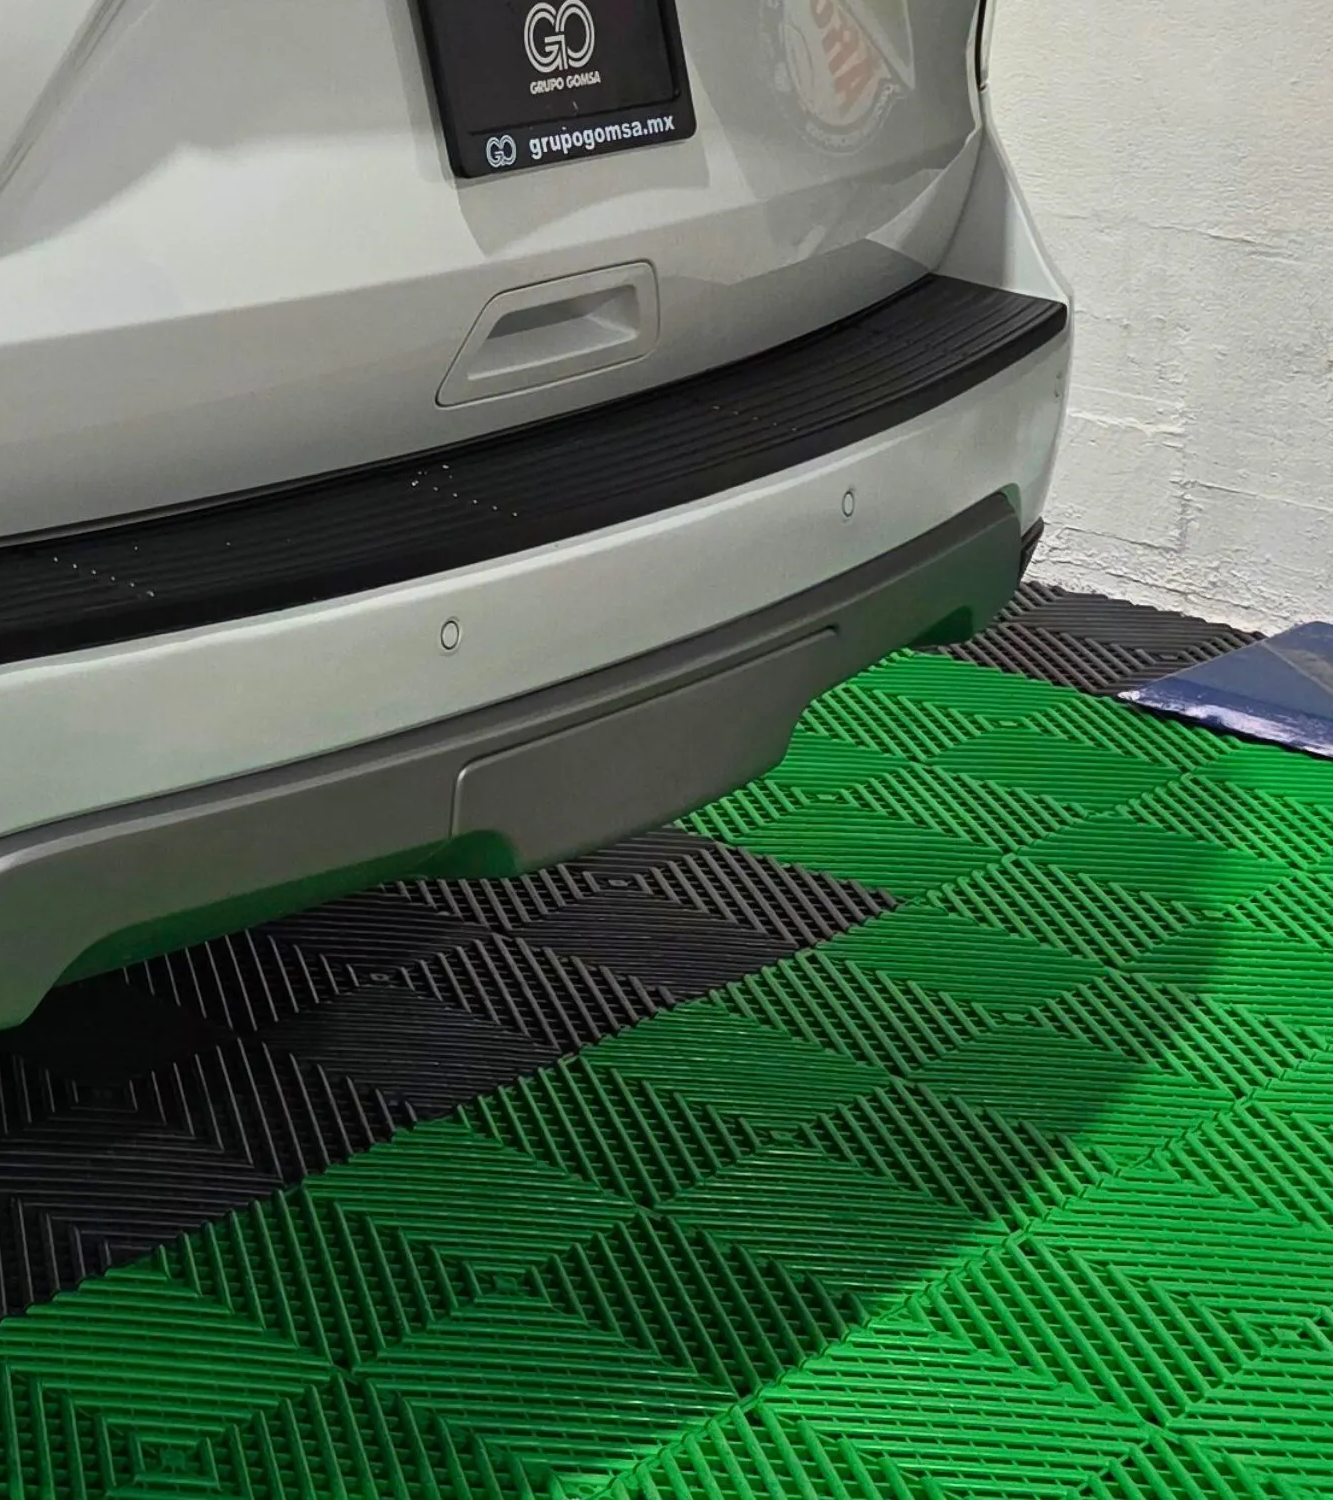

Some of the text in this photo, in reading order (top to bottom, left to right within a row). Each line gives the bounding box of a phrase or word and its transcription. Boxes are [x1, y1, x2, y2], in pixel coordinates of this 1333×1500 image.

[529, 70, 601, 95] GRUPO GOMSA
[529, 115, 675, 160] grupogomsa.mx
